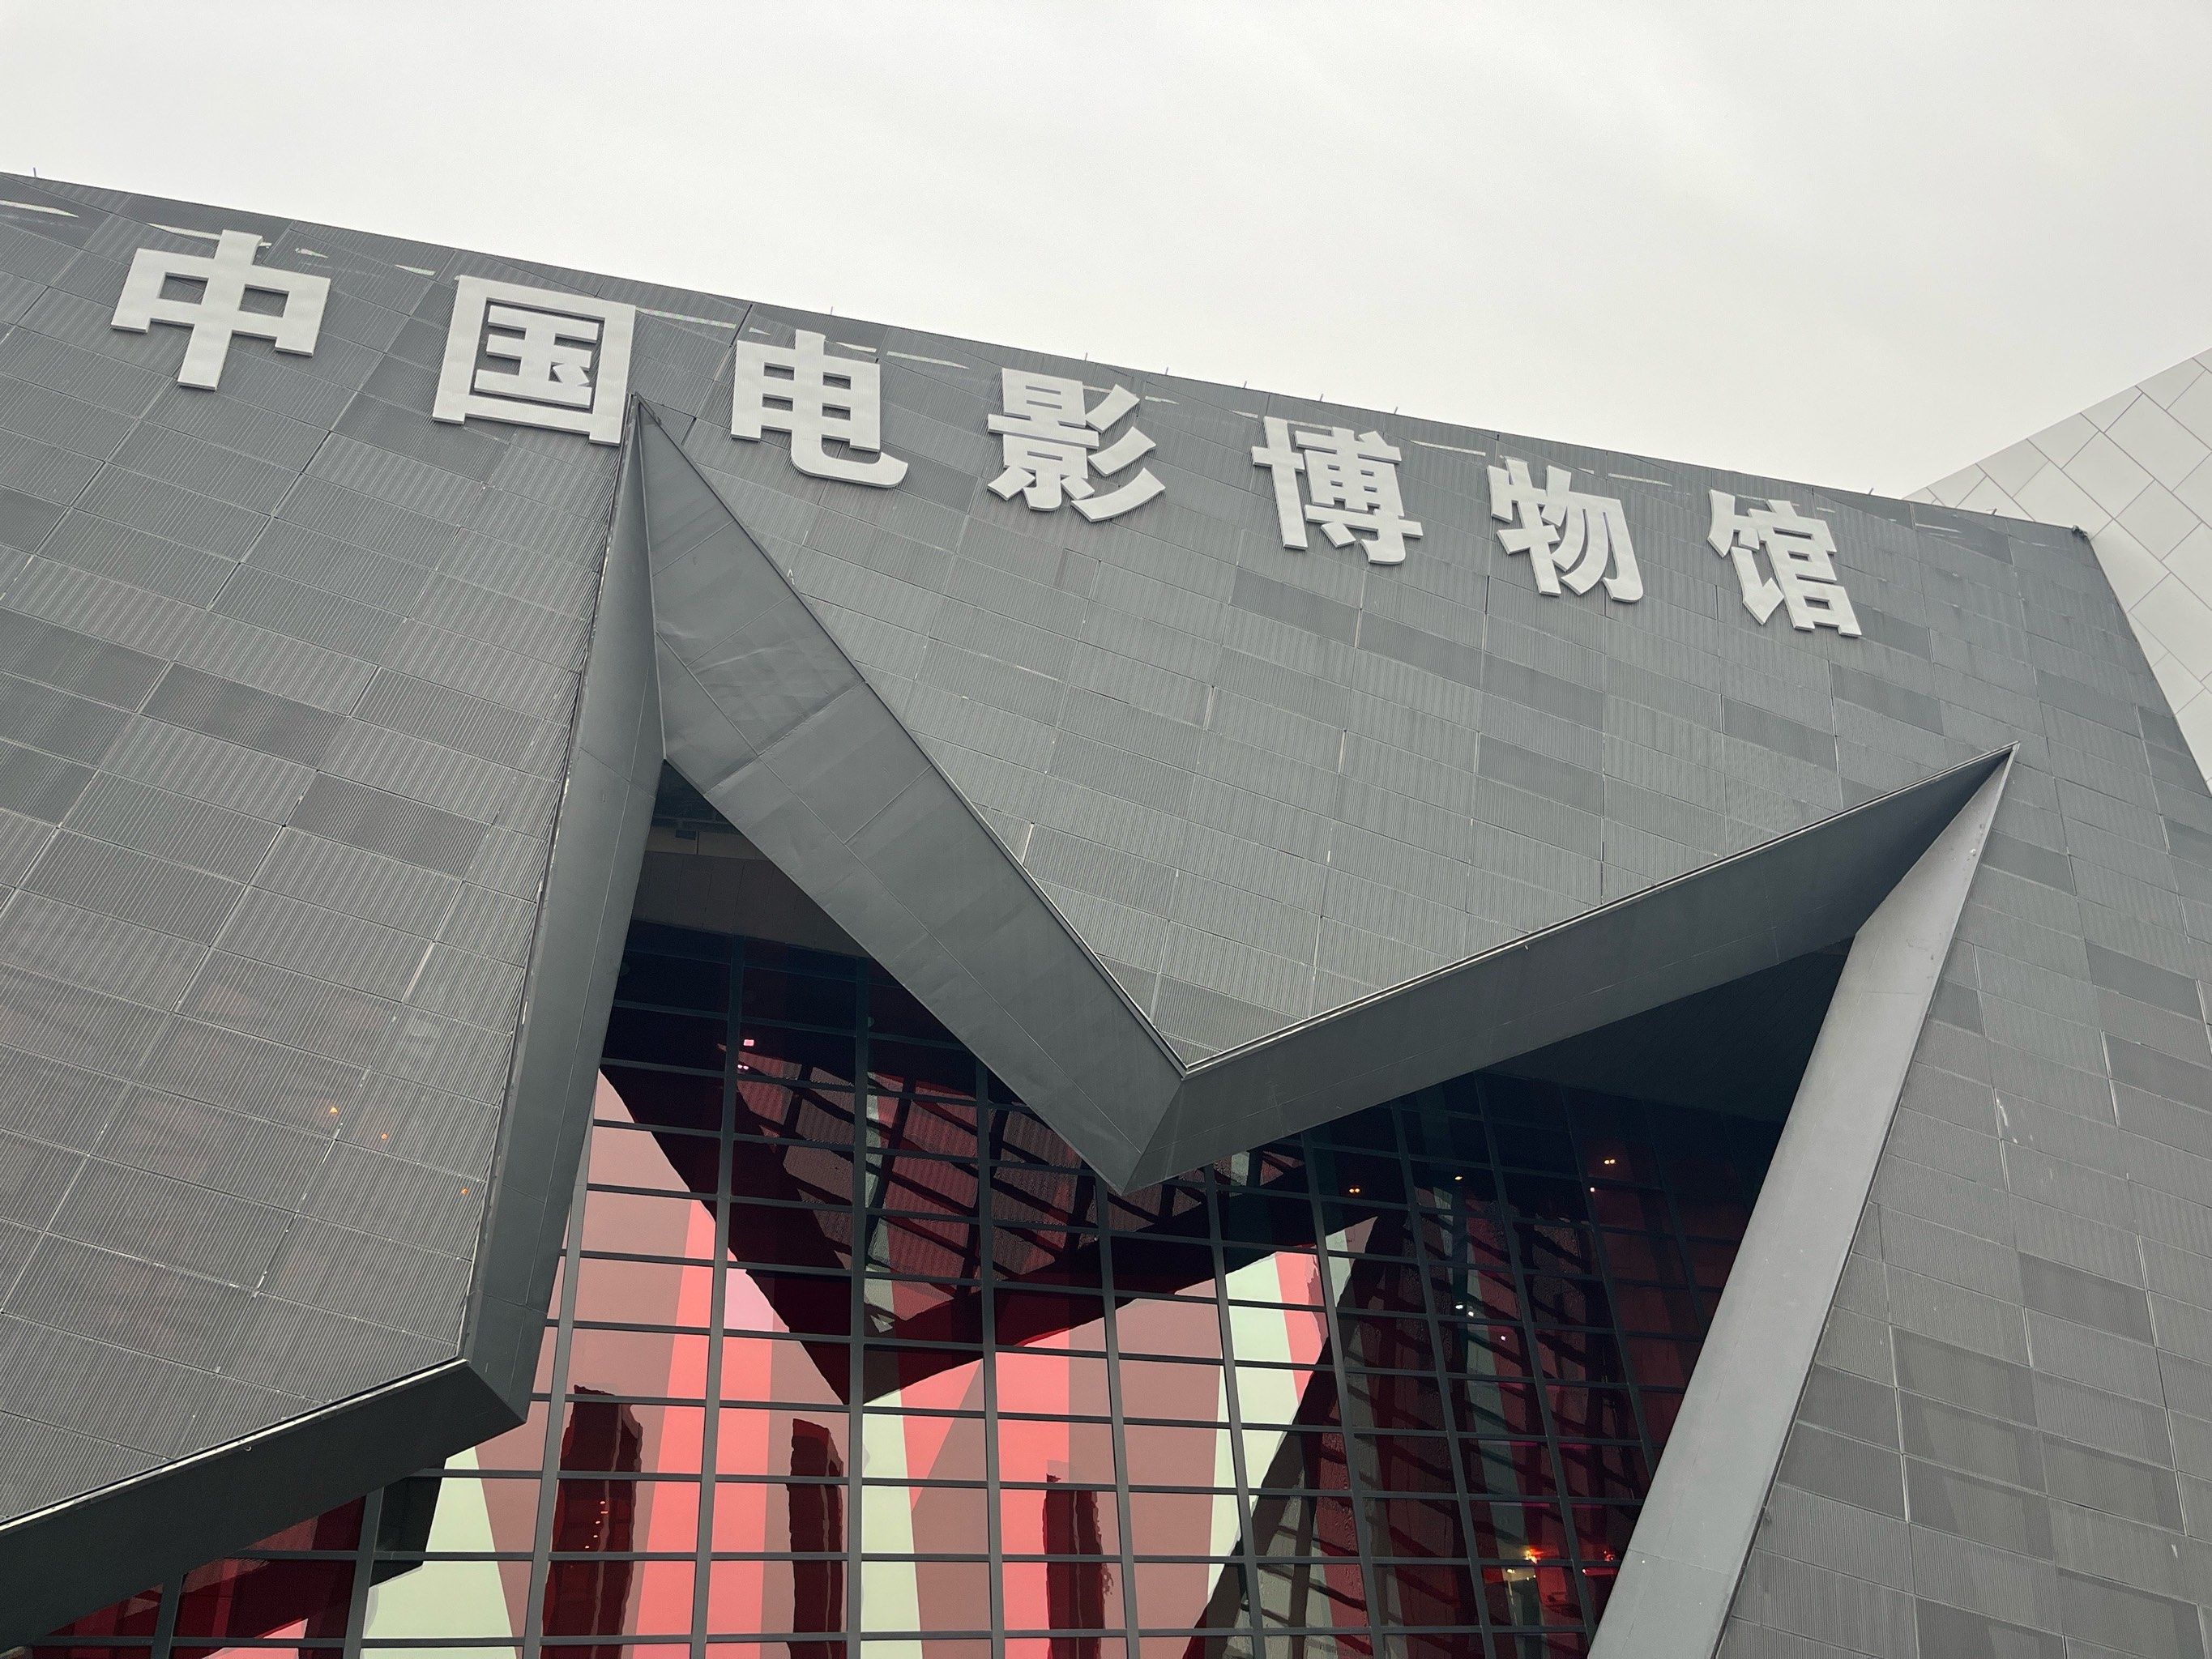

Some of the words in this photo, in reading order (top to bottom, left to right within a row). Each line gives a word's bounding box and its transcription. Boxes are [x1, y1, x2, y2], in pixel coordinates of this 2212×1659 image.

[111, 226, 1862, 638] 中国电影博物馆
